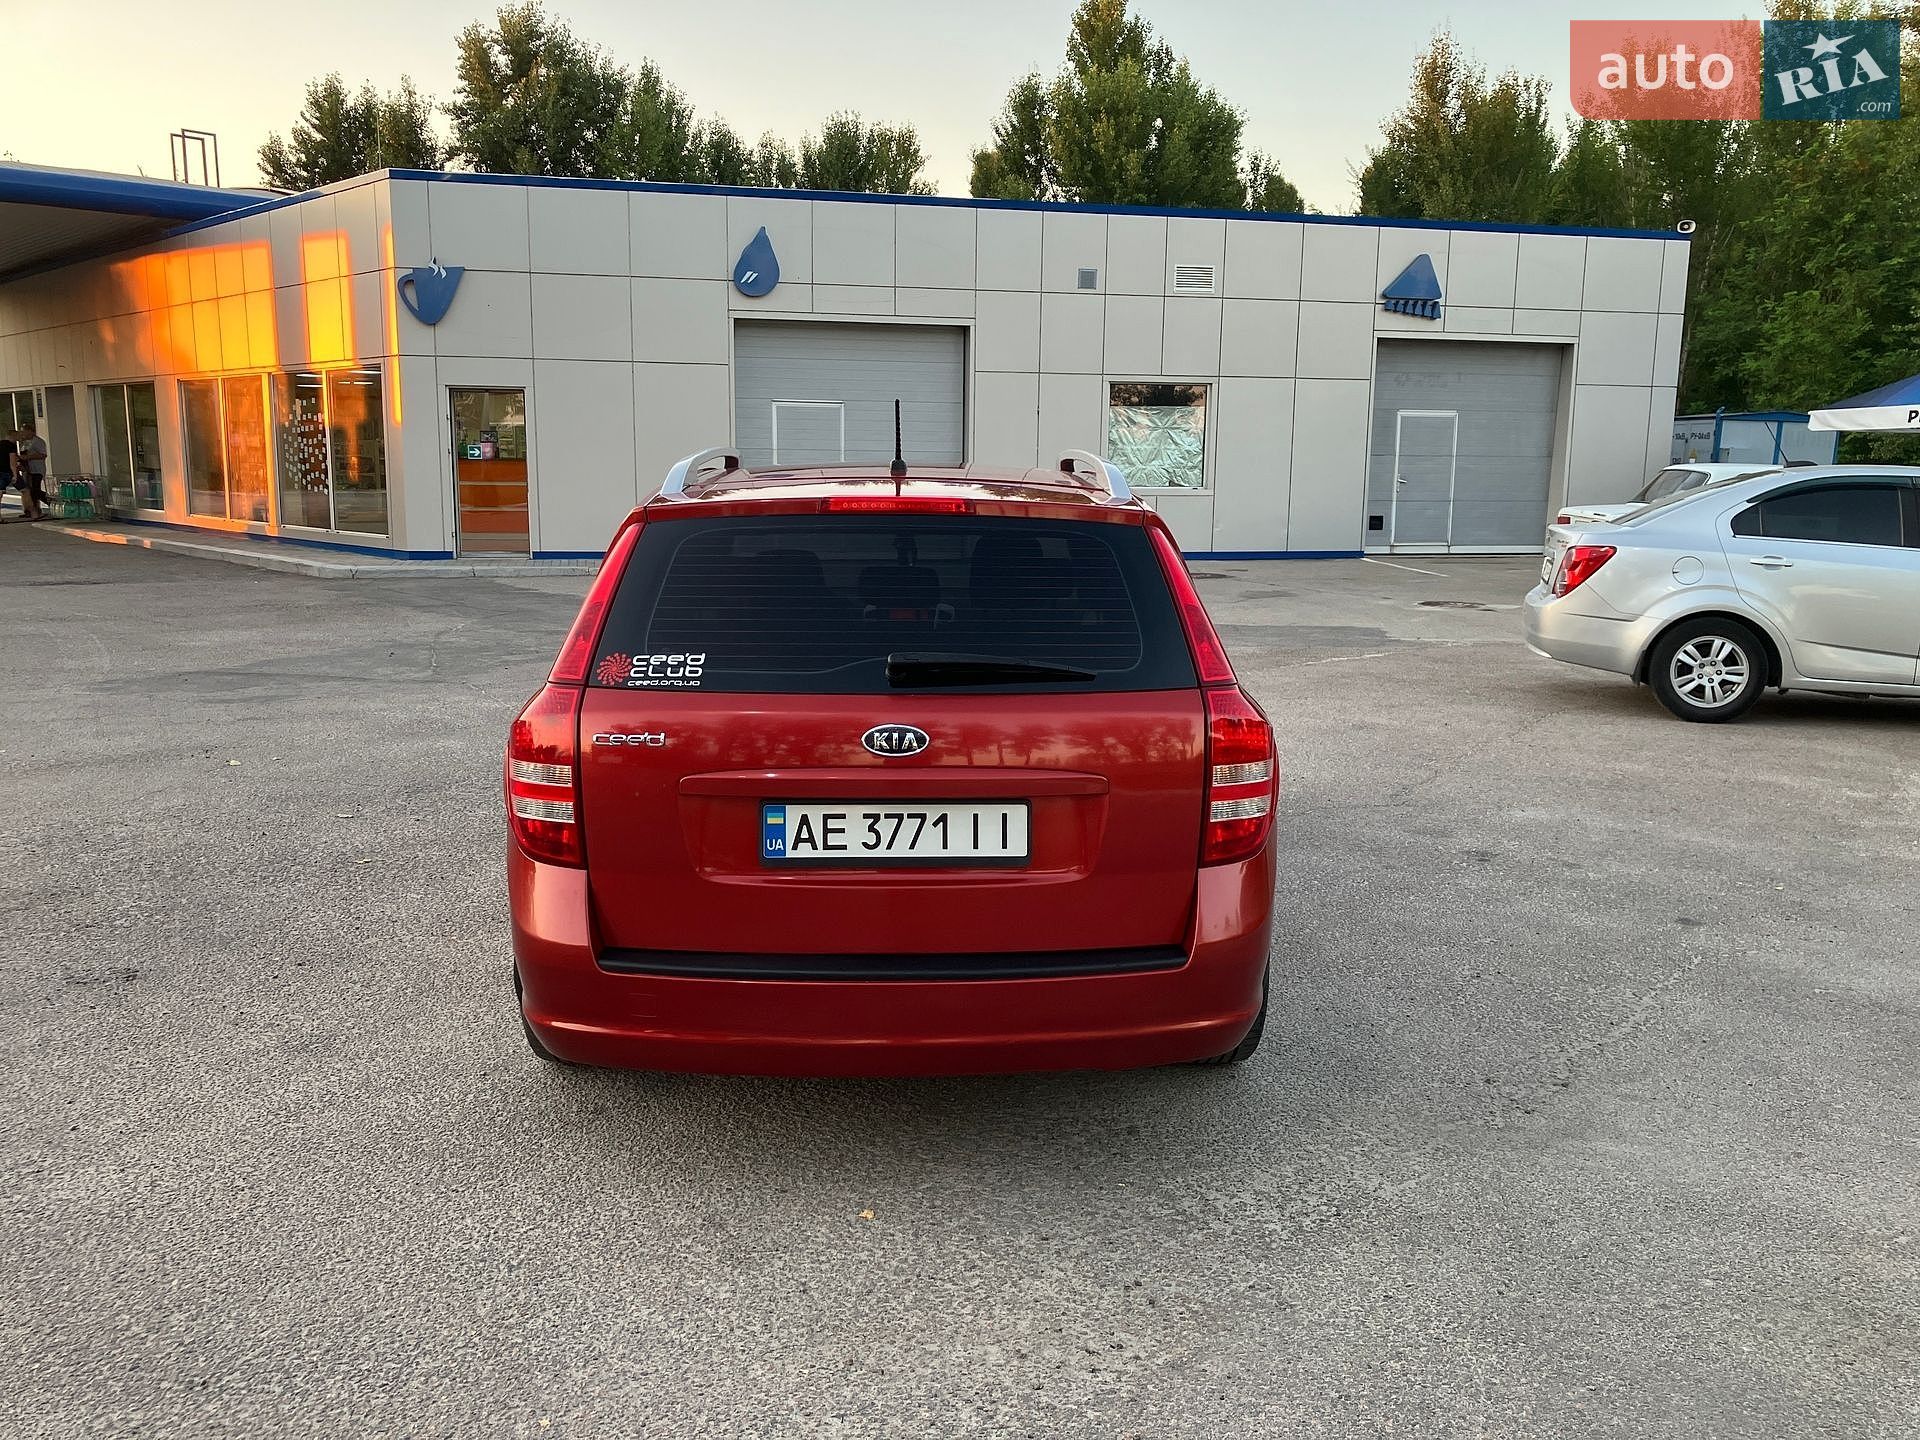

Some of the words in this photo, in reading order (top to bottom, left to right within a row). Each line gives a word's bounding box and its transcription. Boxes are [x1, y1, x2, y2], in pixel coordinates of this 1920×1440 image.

[873, 732, 919, 750] KIA
[791, 813, 848, 851] AE
[861, 812, 949, 850] 3771
[766, 839, 784, 851] UA
